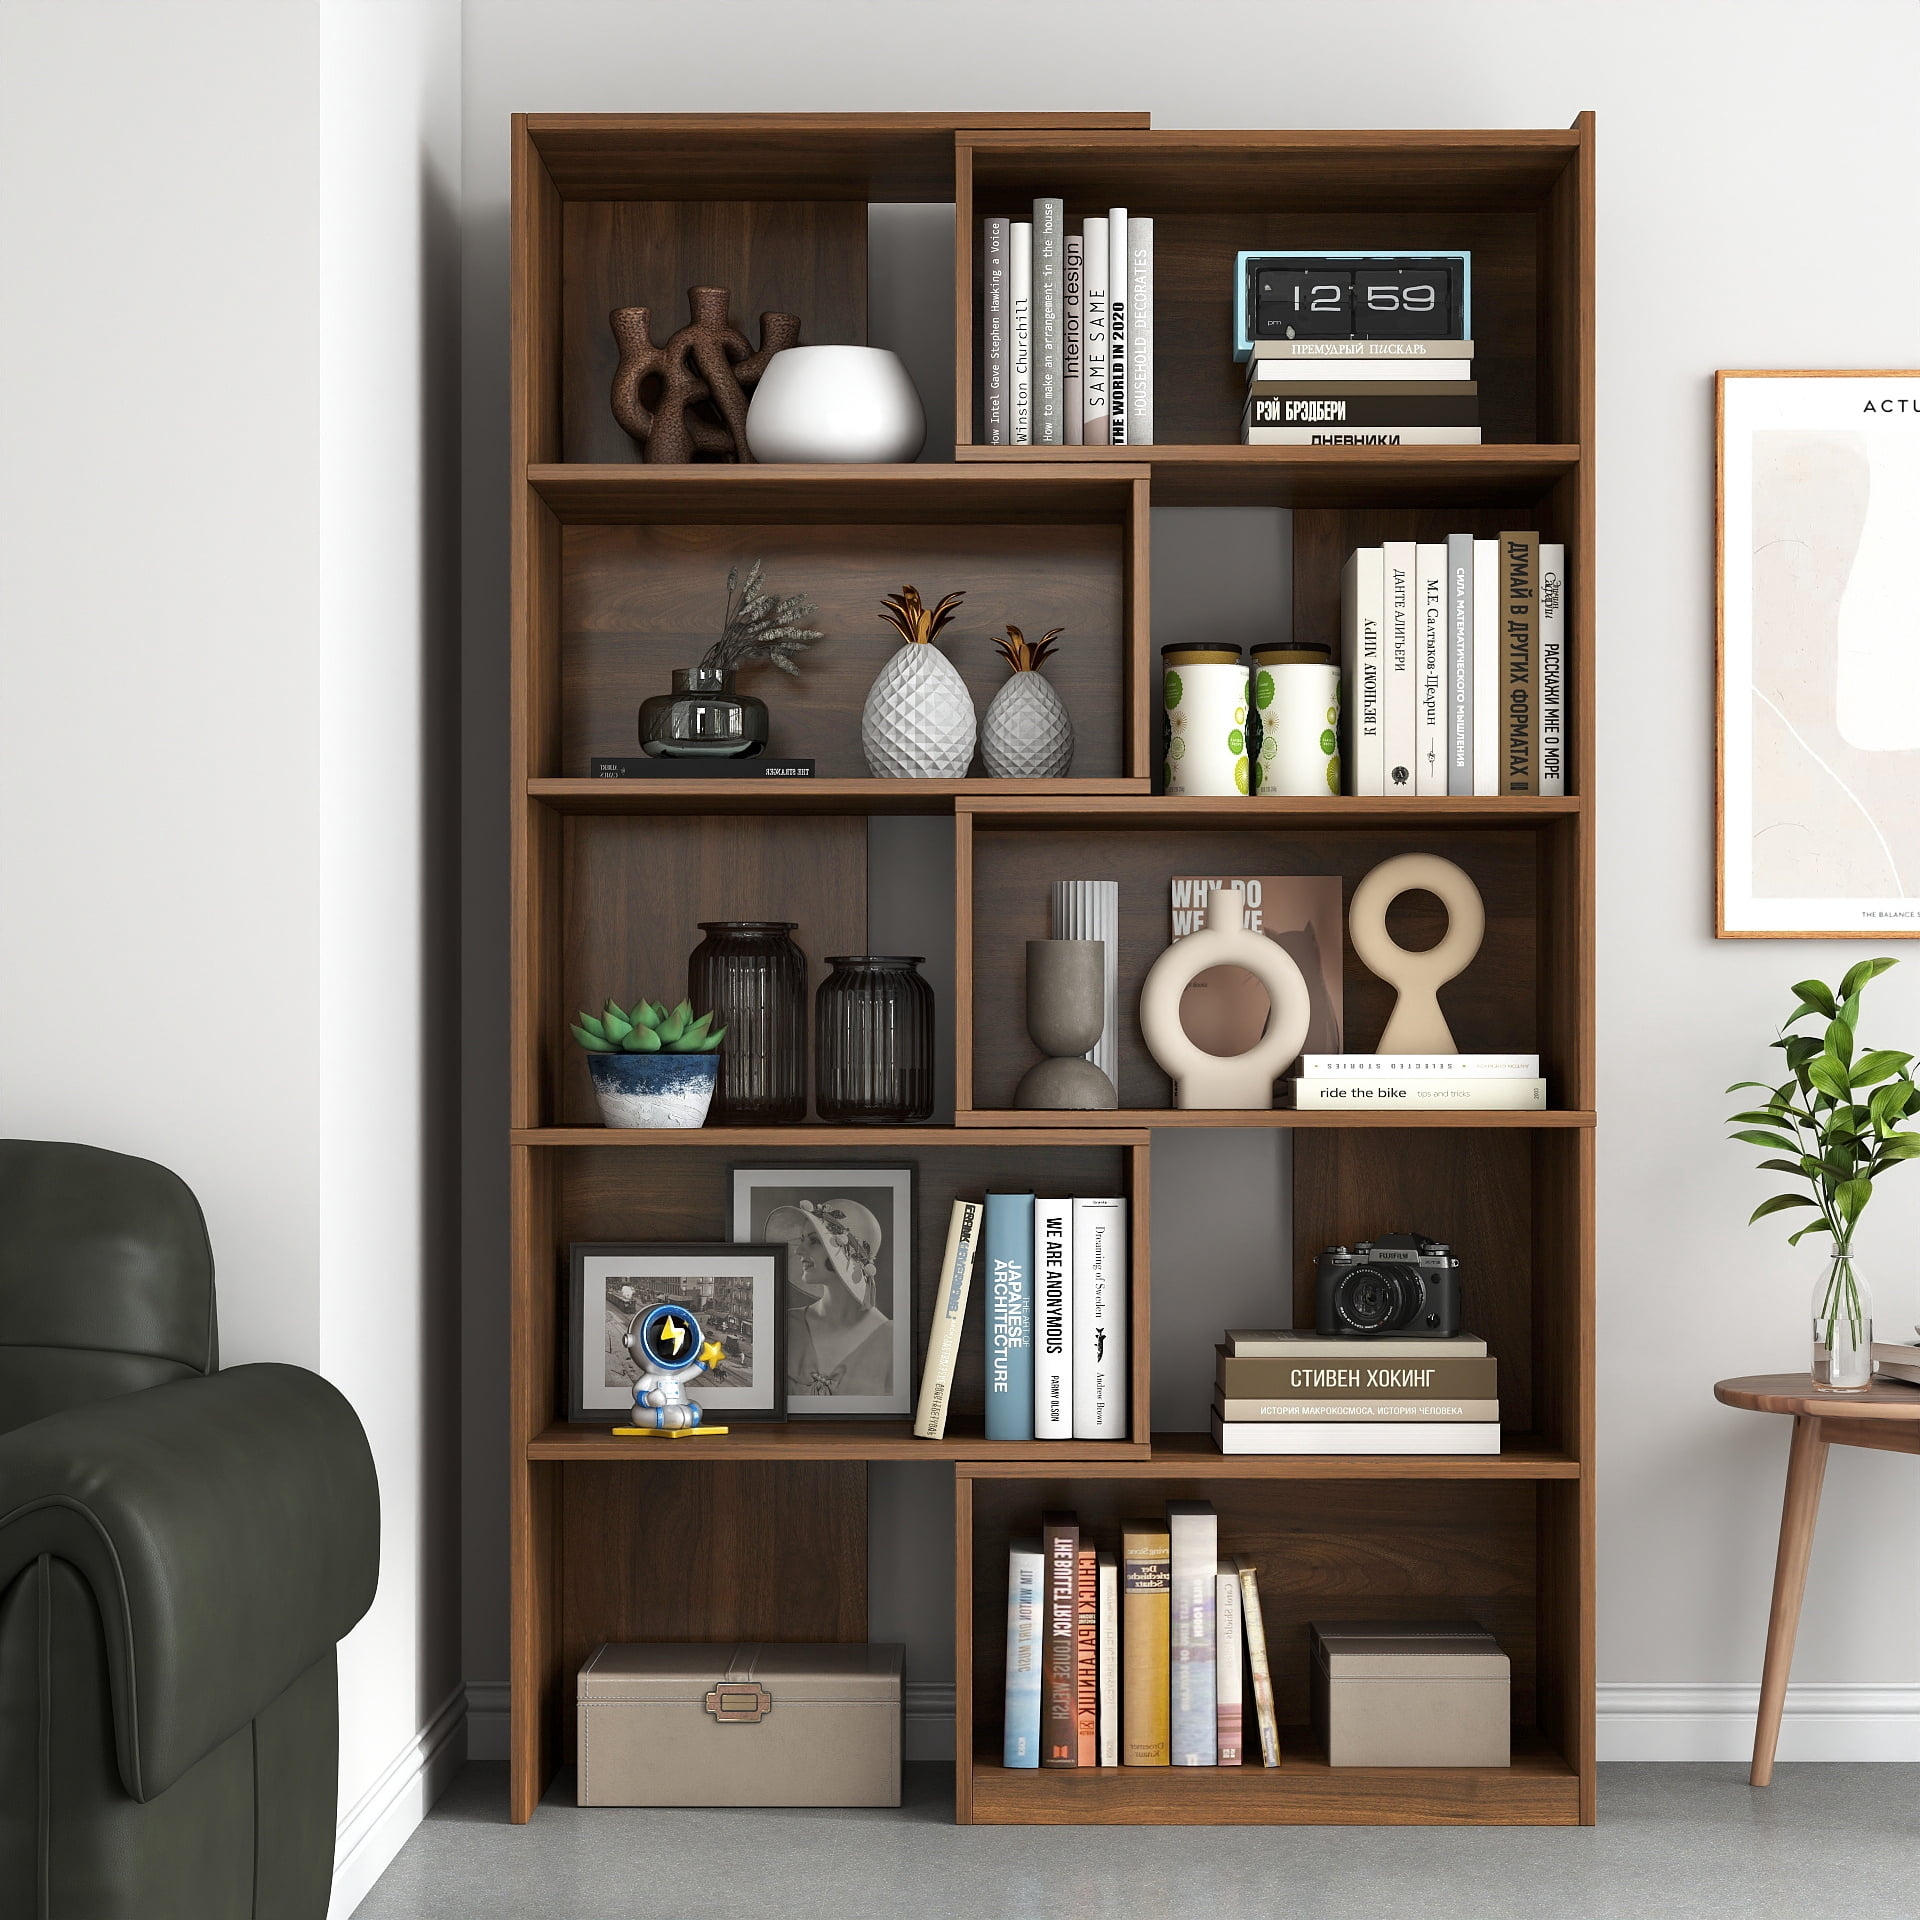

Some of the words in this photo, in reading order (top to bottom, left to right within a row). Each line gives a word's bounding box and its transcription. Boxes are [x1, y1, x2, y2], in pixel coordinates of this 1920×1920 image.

[1043, 203, 1053, 239] house
[991, 223, 1000, 253] Voice
[1043, 239, 1053, 258] the
[993, 257, 1000, 265] a
[1043, 263, 1053, 277] in
[1064, 243, 1083, 306] design
[991, 270, 1002, 312] Hawking
[1134, 249, 1147, 328] DECORATES
[1294, 285, 1341, 312] 12
[1367, 284, 1435, 311] 59
[1044, 282, 1056, 348] arrangement
[1090, 290, 1105, 341] SAME
[1113, 302, 1125, 340] 2020
[991, 315, 1002, 358] Stephen
[1016, 298, 1028, 374] Churchill
[1064, 312, 1079, 379] Interior
[1291, 342, 1364, 355] ПРЕМУДРЫЙ
[1045, 356, 1053, 367] an
[1113, 343, 1125, 360] IN
[991, 365, 1000, 387] Gave
[1043, 375, 1053, 398] make
[1090, 354, 1105, 406] SAME
[1113, 363, 1125, 417] WORLD
[1134, 336, 1147, 416] HOUSEHOLD
[991, 394, 1000, 423] Intel
[1016, 382, 1028, 442] Winston
[1044, 404, 1053, 416] to
[1256, 397, 1280, 421] РЭЙ
[1285, 401, 1346, 422] БРЭДБЕРИ
[1043, 423, 1053, 441] How
[1113, 419, 1125, 445] THE
[1456, 567, 1465, 596] СИЛА
[1508, 541, 1533, 599] ДУМАЙ
[1393, 569, 1406, 608] ДАНТЕ
[1427, 579, 1439, 606] М.Е.
[1510, 605, 1529, 615] В
[1364, 618, 1377, 658] МИРУ
[1394, 610, 1406, 671] АЛИГЬЕРИ
[1456, 600, 1465, 703] МАТЕМАТИЧЕСКОГО
[1508, 620, 1529, 684] ДРУГИХ
[1423, 608, 1439, 725] Салтыков-Щедрин
[1544, 643, 1560, 705] РАССКАЖИ
[1364, 663, 1377, 724] ВЕЧНОМУ
[1364, 727, 1377, 736] К
[1509, 688, 1529, 776] ФОРМАТАХ
[1544, 708, 1560, 733] МНЕ
[1456, 705, 1465, 767] МЫШЛЕНИЯ
[1544, 748, 1560, 779] МОРЕ
[1320, 1087, 1347, 1099] ride
[1351, 1087, 1374, 1099] the
[1378, 1087, 1407, 1099] bike
[1417, 1089, 1432, 1100] tips
[1433, 1089, 1448, 1099] and
[1450, 1089, 1471, 1099] tricks
[1046, 1217, 1063, 1238] WE
[1046, 1241, 1063, 1267] ARE
[1093, 1226, 1106, 1270] Dreaming
[1096, 1272, 1106, 1282] of
[1008, 1259, 1022, 1348] JAPANESE
[1046, 1271, 1063, 1354] ANONYMOUS
[1095, 1283, 1106, 1318] Sweden
[994, 1258, 1008, 1393] ARCHITECTURE
[1023, 1335, 1030, 1348] OF
[1050, 1375, 1059, 1399] PARMY
[1096, 1372, 1105, 1400] Andrew
[1290, 1369, 1360, 1387] СТИВЕН
[1366, 1369, 1436, 1387] ХОКИНГ
[1050, 1400, 1059, 1422] OLSON
[1096, 1402, 1105, 1425] Brown
[1260, 1406, 1300, 1415] ИСТОРИЯ
[1301, 1406, 1375, 1416] МАКРОКОСМОСА,
[1377, 1406, 1417, 1415] ИСТОРИЯ
[1418, 1406, 1463, 1415] ЧЕЛОВЕКА
